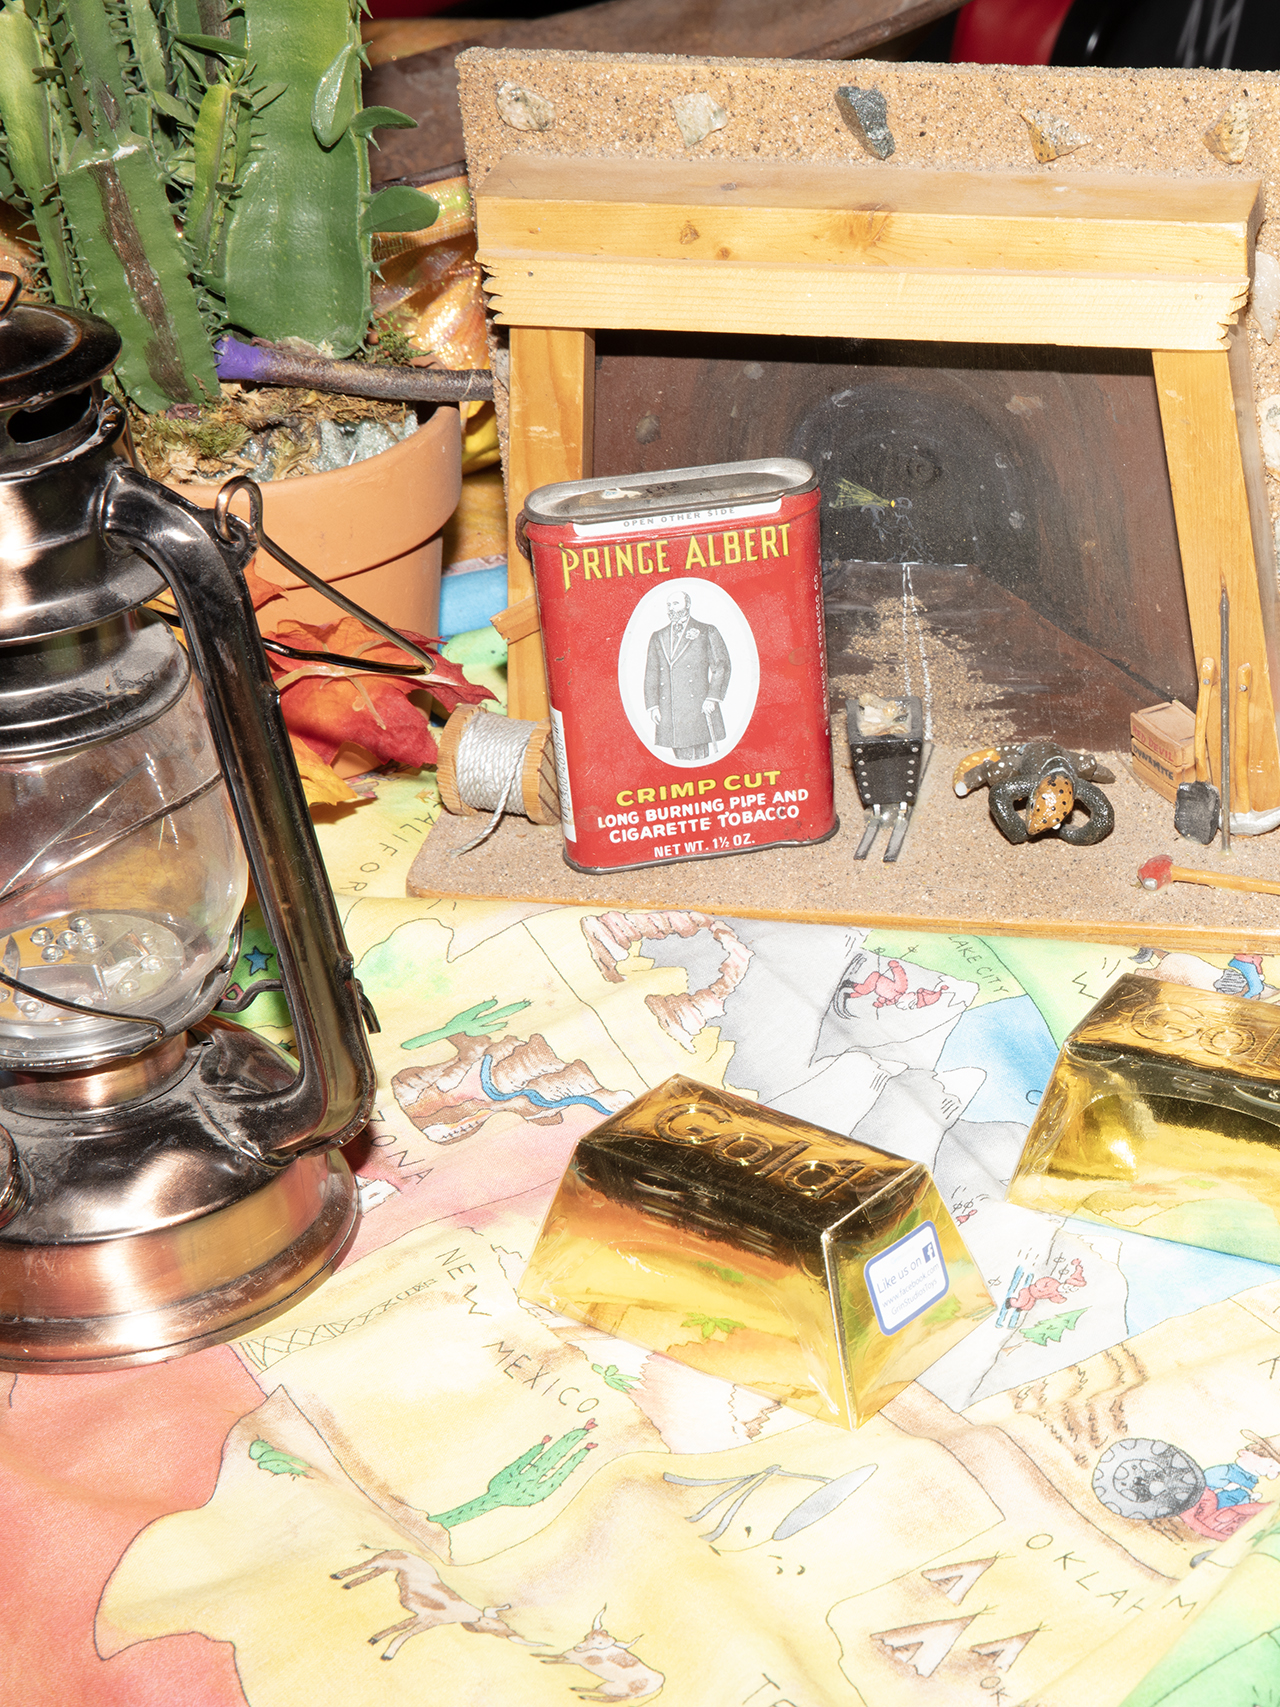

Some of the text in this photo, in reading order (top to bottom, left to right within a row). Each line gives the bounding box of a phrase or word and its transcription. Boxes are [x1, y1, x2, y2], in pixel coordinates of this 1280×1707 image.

[623, 507, 735, 528] OPEN OTHER SIDE
[558, 523, 791, 593] PRINCE ALBERT
[814, 594, 823, 648] TOBACCO
[1132, 724, 1174, 763] RED DEVIL
[616, 770, 782, 807] CRIMP CUT
[597, 788, 809, 829] LONG BURNING PIPE AND
[609, 805, 800, 844] CIGARETTE TOBACCO
[654, 843, 681, 858] NET
[684, 840, 709, 854] WT.
[733, 833, 755, 847] OZ.
[976, 966, 1009, 993] CITY
[653, 1102, 866, 1200] Gold
[876, 1275, 896, 1294] Like
[898, 1266, 909, 1280] us
[910, 1257, 922, 1271] on
[882, 1263, 940, 1308] www.facebook.com
[891, 1279, 938, 1316] GrinStudiosToys
[435, 1247, 599, 1414] NEW MEXICO
